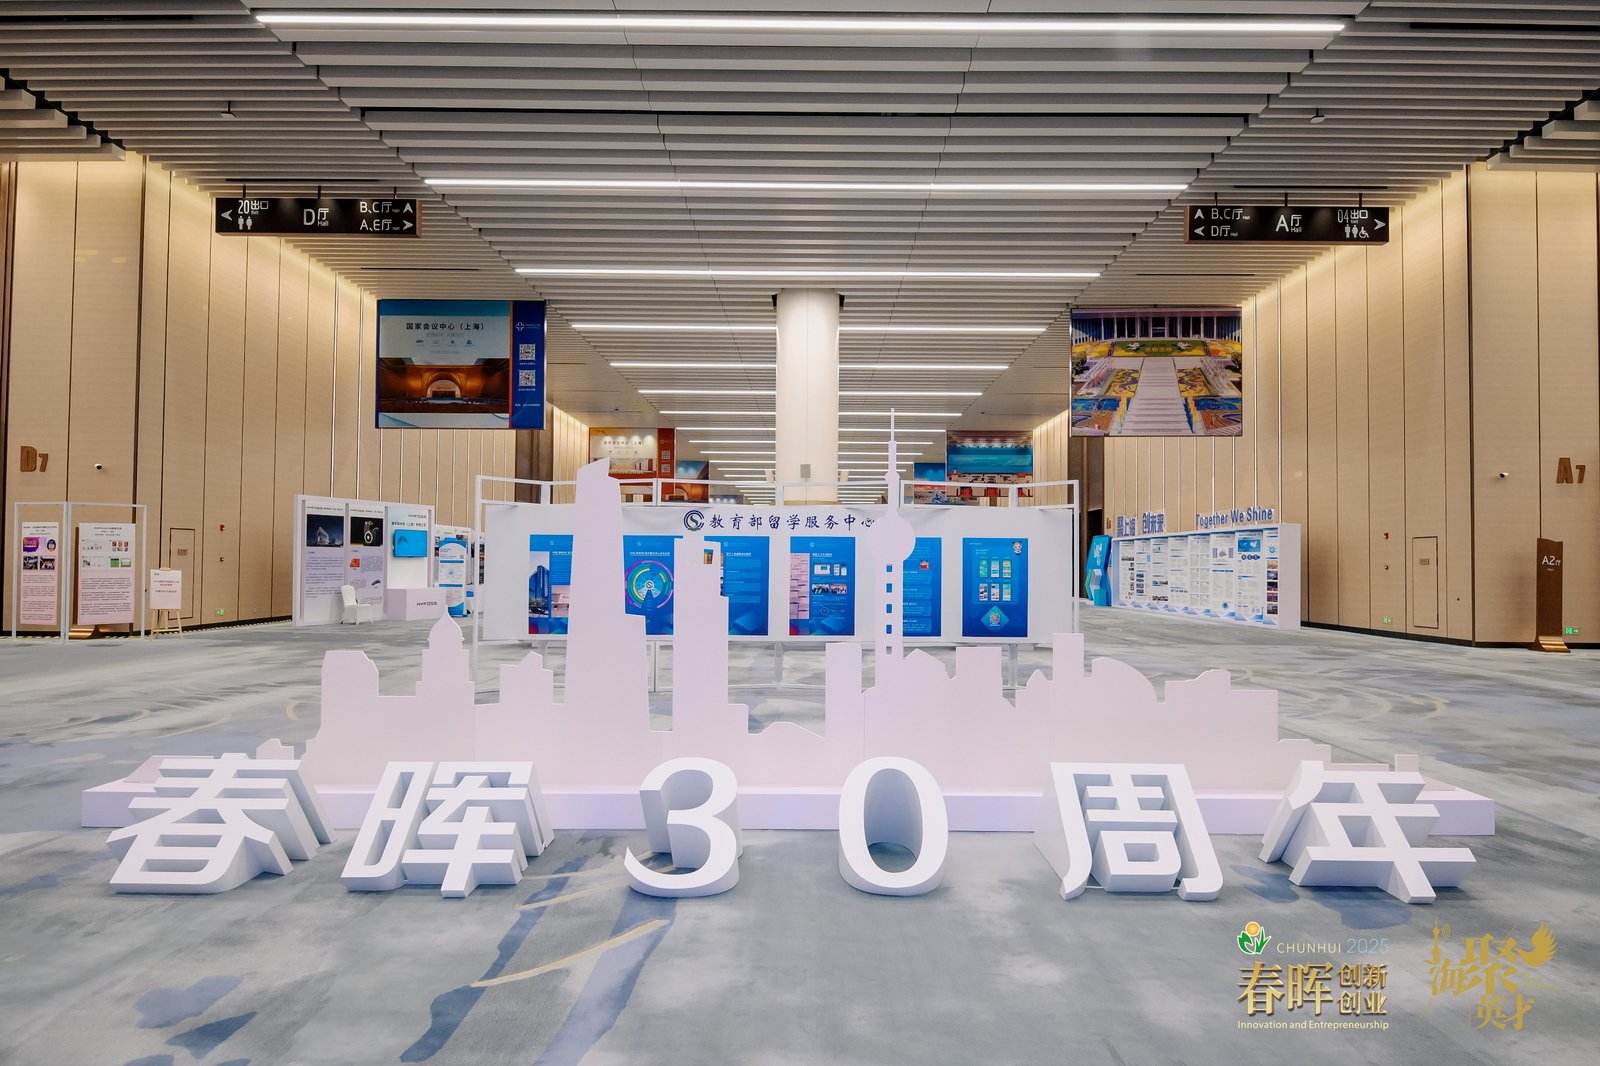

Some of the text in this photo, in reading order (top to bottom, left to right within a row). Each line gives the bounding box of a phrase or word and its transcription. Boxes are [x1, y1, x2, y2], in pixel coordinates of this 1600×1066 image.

[237, 199, 269, 214] 20出口
[359, 201, 392, 213] B、C厅
[1210, 208, 1243, 220] B、C厅
[303, 207, 329, 226] D厅
[317, 219, 329, 227] Hall
[1275, 214, 1302, 232] A厅
[1337, 208, 1369, 223] 04出口
[1210, 225, 1231, 237] D厅
[406, 322, 485, 331] 国家会议中心（上海）
[19, 445, 49, 473] D7
[1556, 457, 1586, 484] A7
[708, 513, 875, 531] 教育部留学服务中心
[1195, 506, 1273, 529] Together We Shine
